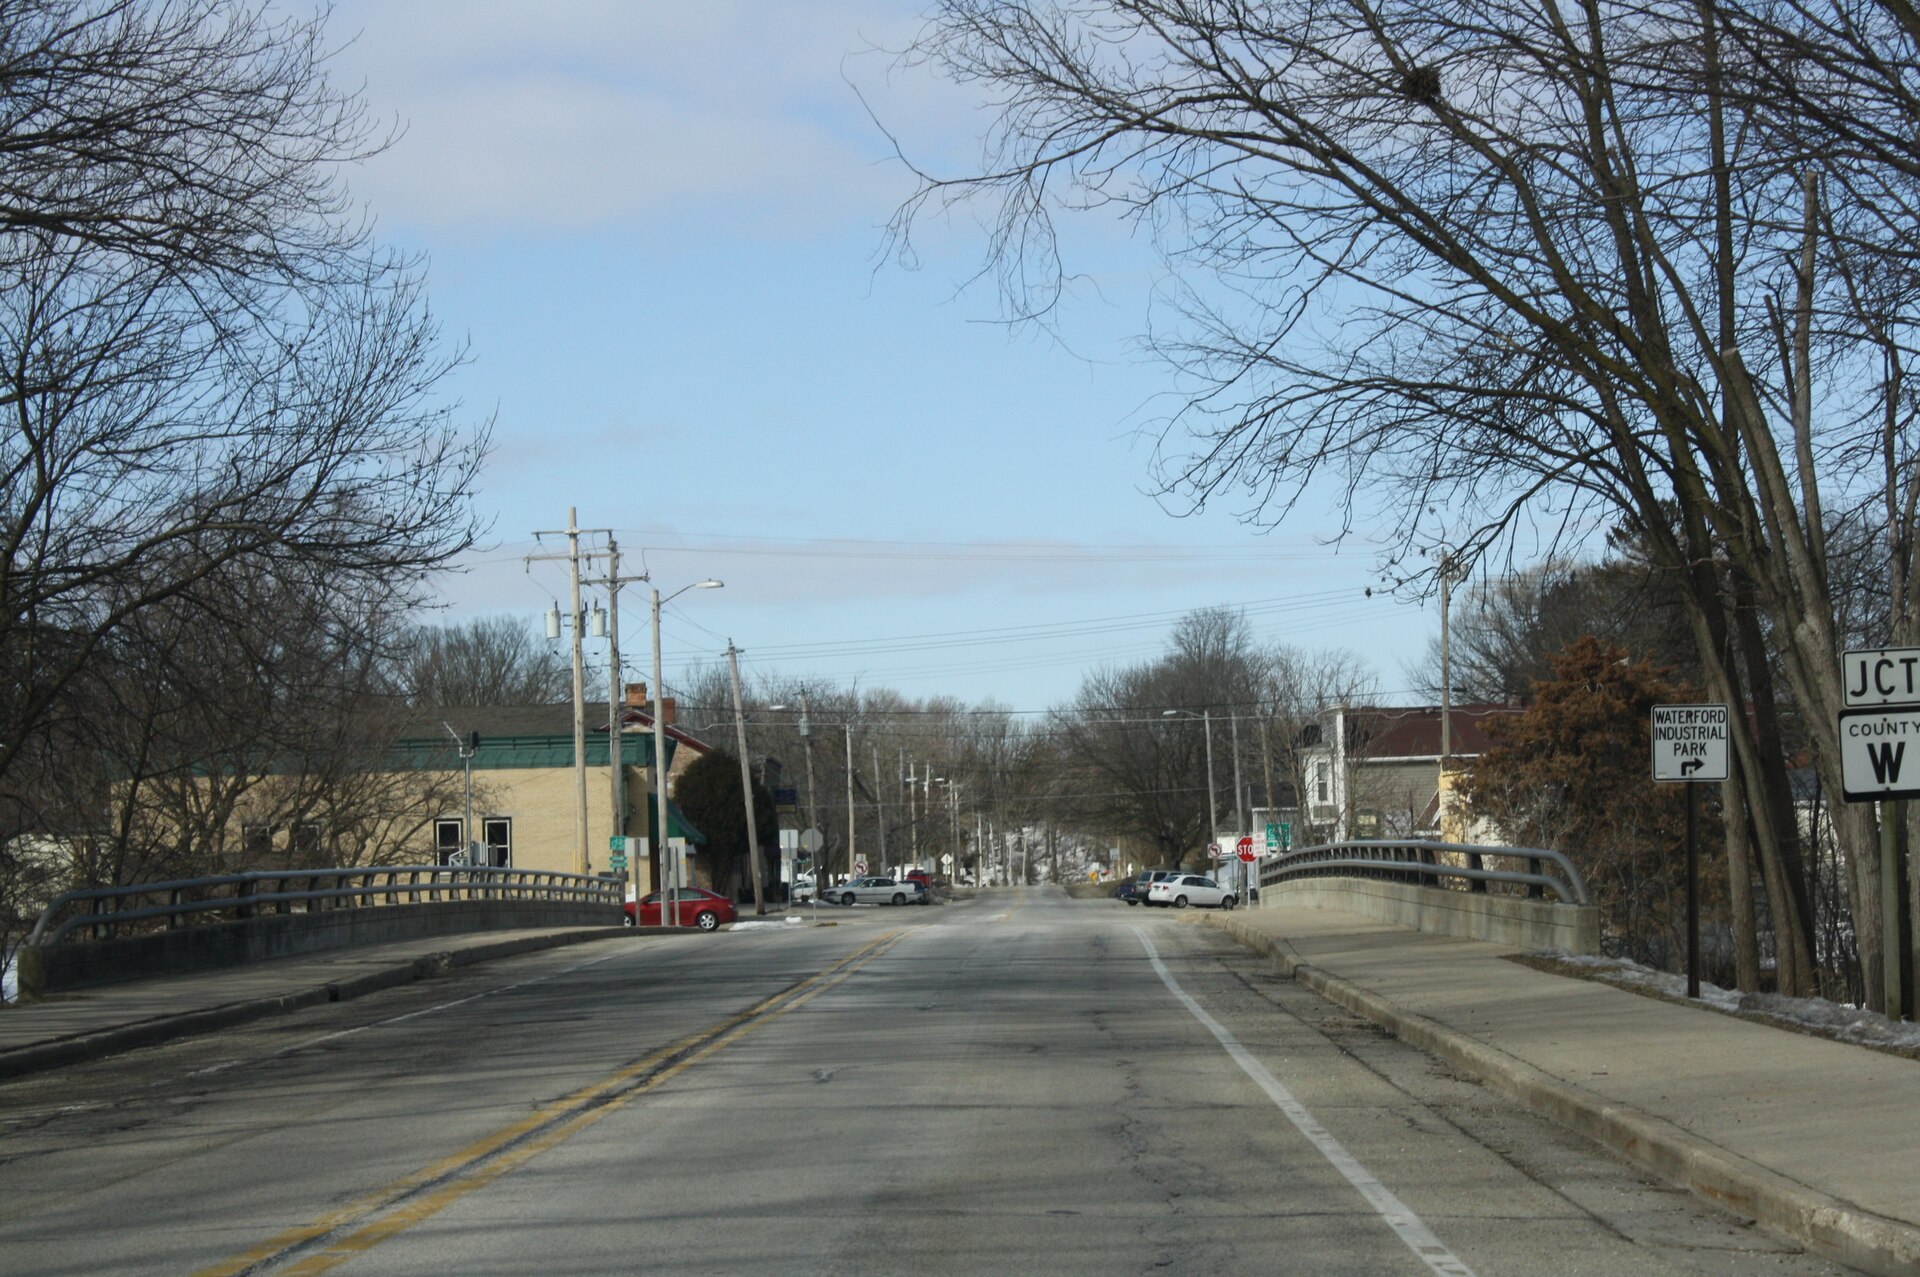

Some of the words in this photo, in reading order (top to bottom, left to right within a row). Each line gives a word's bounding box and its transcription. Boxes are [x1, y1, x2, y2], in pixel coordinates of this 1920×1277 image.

[1850, 658, 1918, 697] JCT
[1655, 710, 1726, 724] WATERFORD
[1655, 726, 1726, 740] INDUSTRIAL
[1849, 721, 1920, 737] COUNTY
[1673, 742, 1707, 756] PARK
[1866, 741, 1906, 784] W
[1237, 844, 1254, 855] STO
